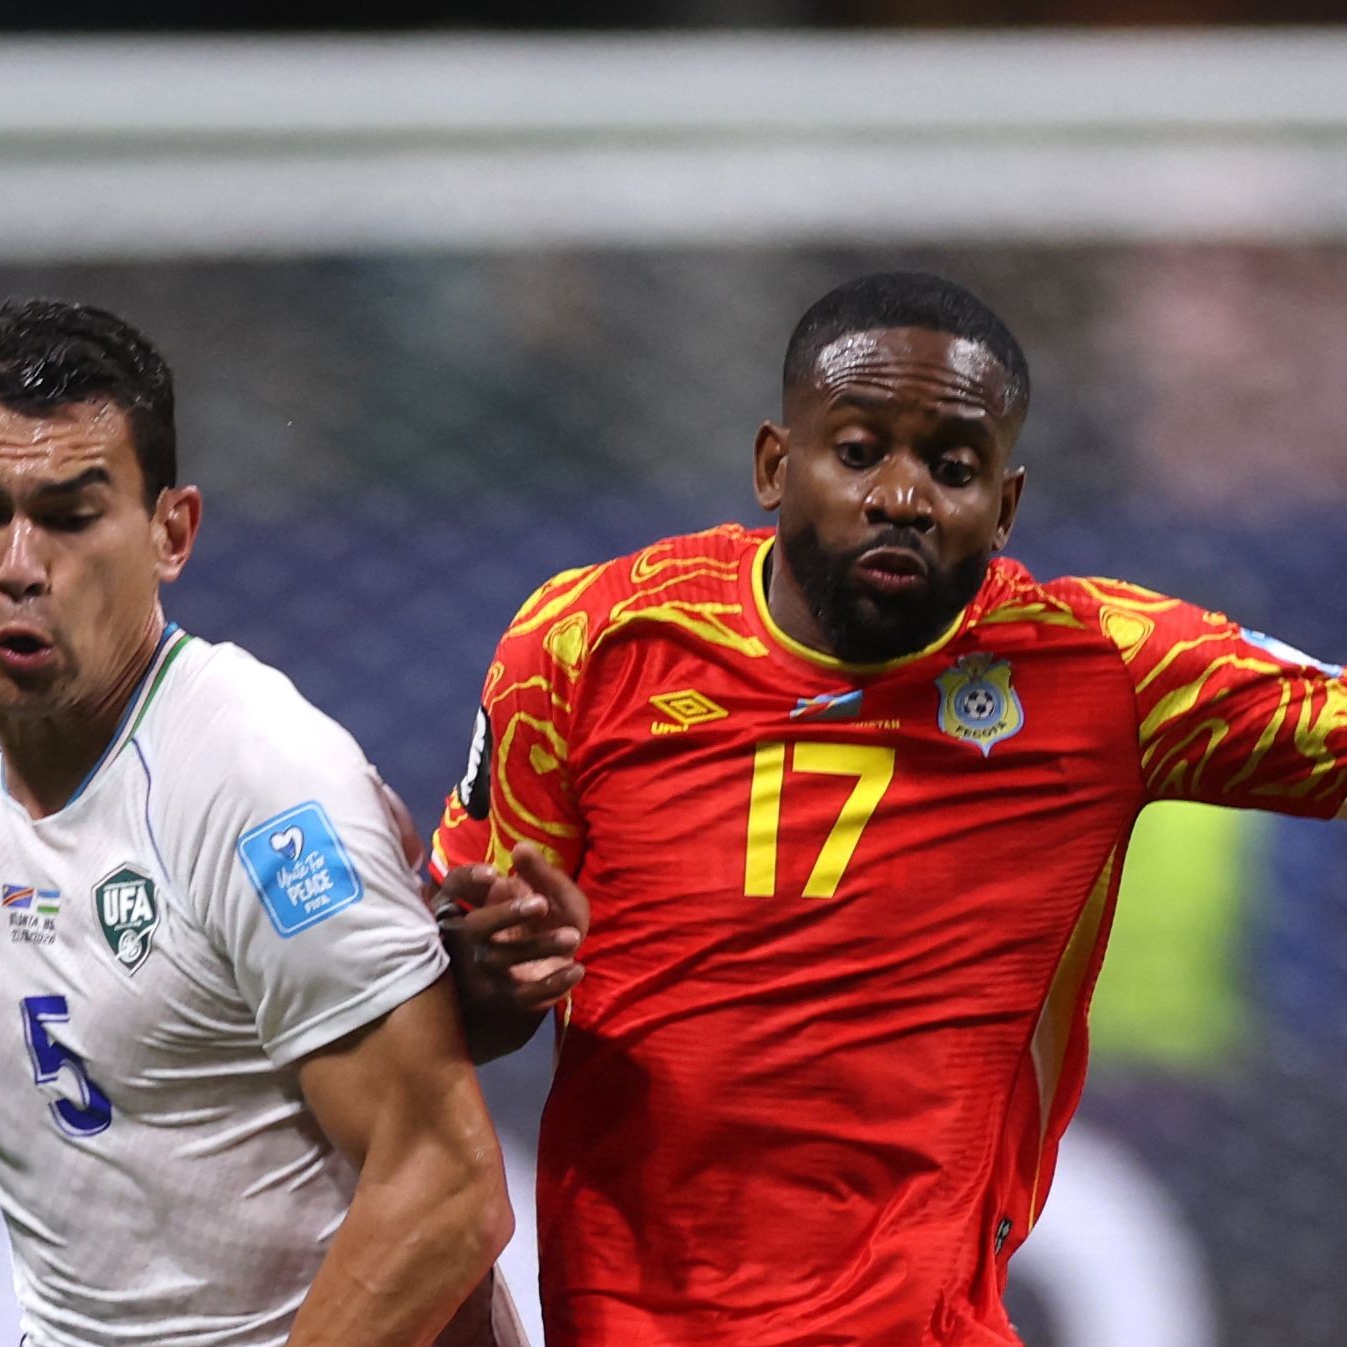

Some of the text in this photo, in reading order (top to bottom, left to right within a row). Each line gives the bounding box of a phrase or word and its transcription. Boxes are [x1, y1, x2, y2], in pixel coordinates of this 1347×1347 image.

[744, 741, 896, 899] 17
[103, 884, 154, 927] UFA
[287, 869, 334, 907] PEACE
[19, 995, 113, 1138] 5
